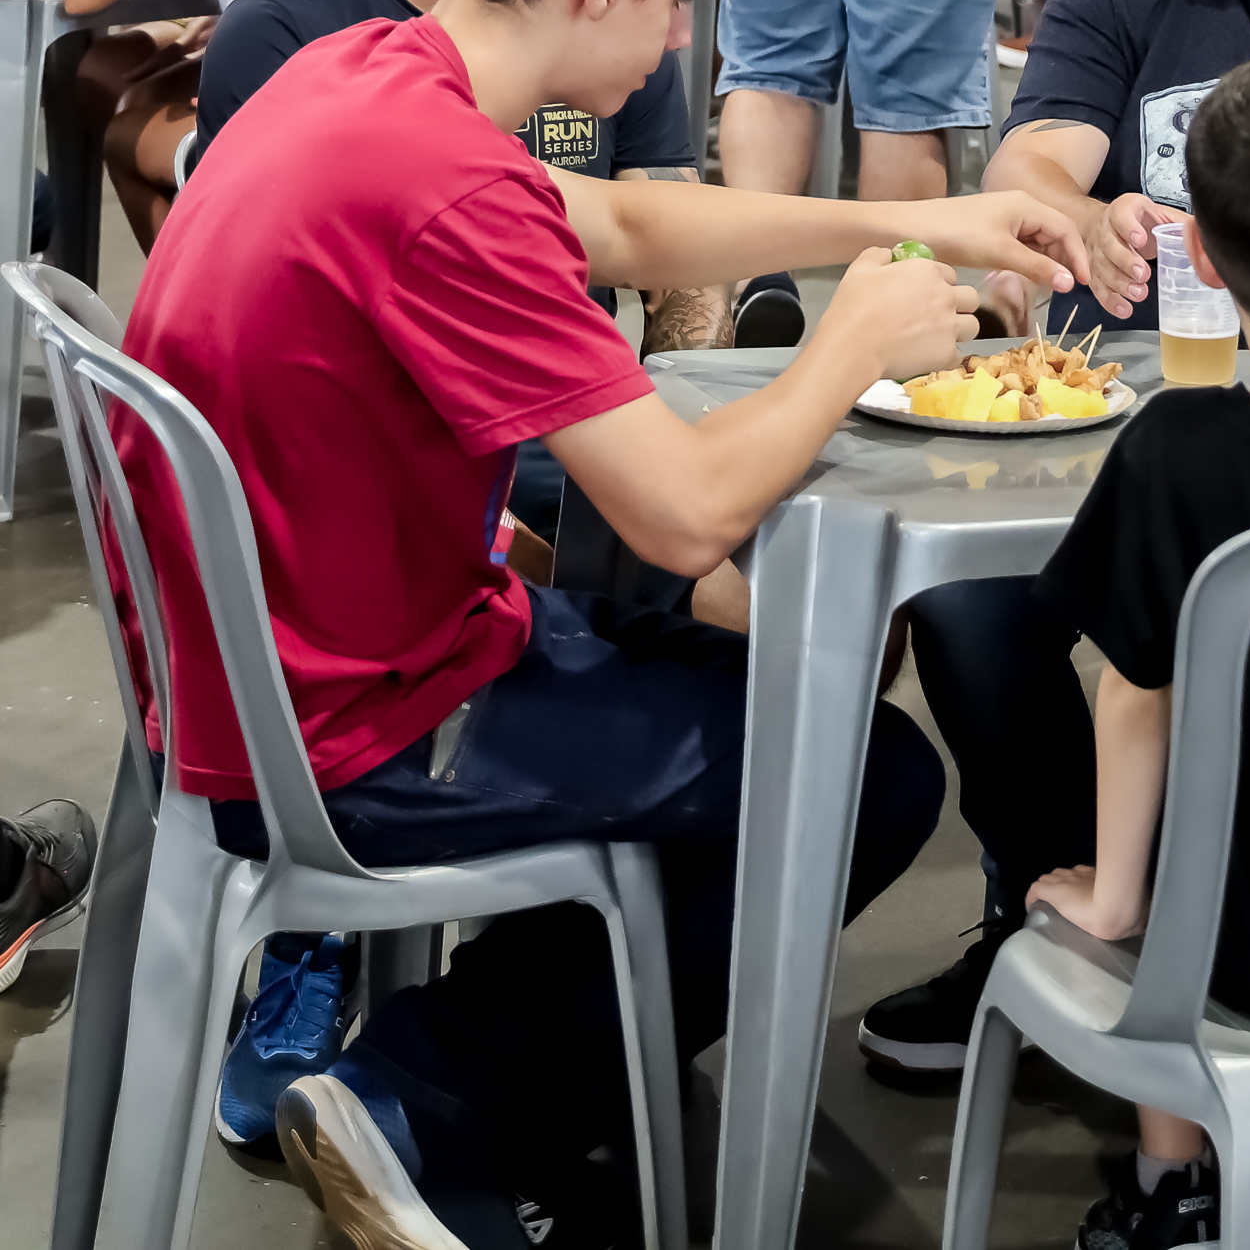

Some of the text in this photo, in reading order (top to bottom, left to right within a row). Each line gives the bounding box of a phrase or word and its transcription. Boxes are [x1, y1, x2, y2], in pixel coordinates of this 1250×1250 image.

[544, 121, 593, 142] RUN
[545, 141, 593, 154] SERIES
[551, 155, 587, 167] AURORA
